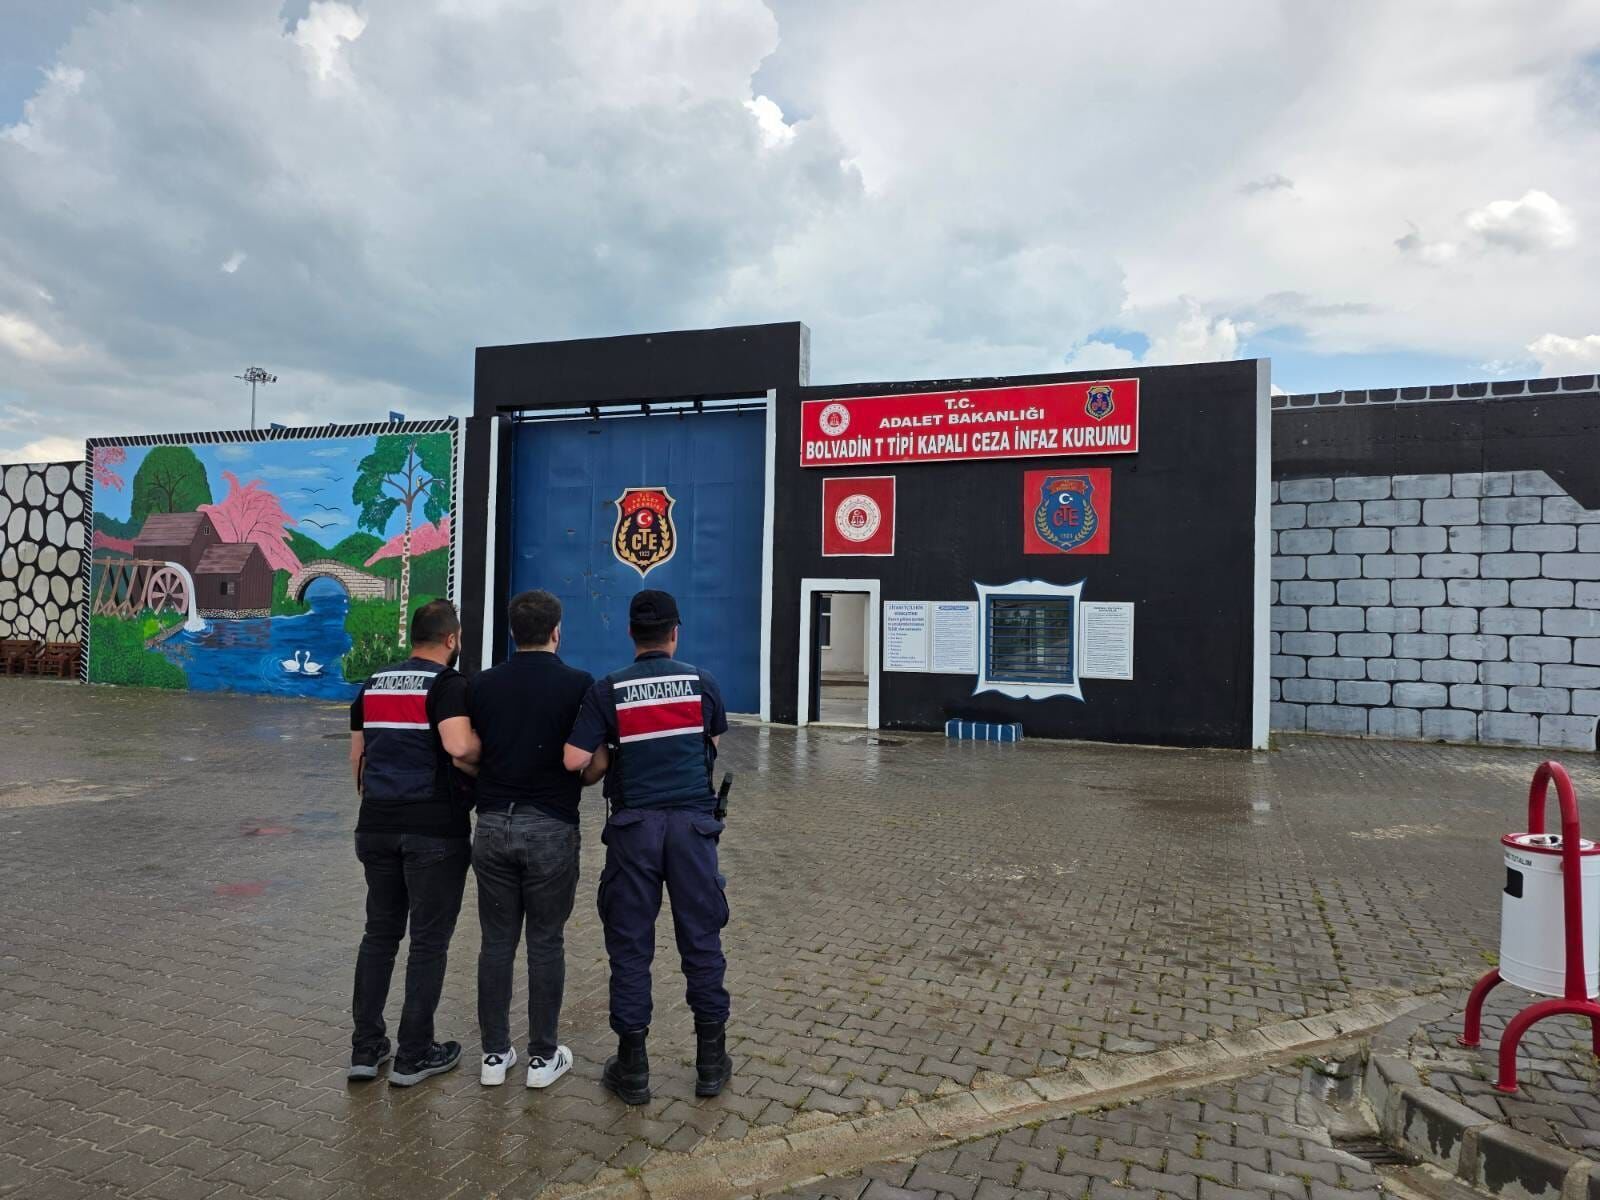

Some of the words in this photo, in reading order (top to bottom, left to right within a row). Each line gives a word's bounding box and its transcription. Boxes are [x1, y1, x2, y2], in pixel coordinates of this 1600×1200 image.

[945, 398, 975, 409] T.C.
[879, 414, 944, 428] ADALET
[948, 407, 1045, 424] BAKANLIĞI
[806, 434, 871, 459] BOLVADİN
[875, 437, 884, 456] T
[887, 432, 914, 455] TİPİ
[917, 433, 967, 454] KAPALI
[971, 431, 1010, 451] CEZA
[1014, 425, 1058, 450] İNFAZ
[1062, 425, 1131, 447] KURUMU
[631, 528, 658, 550] CTE
[371, 676, 425, 690] JANDARMA
[623, 680, 694, 702] JANDARMA
